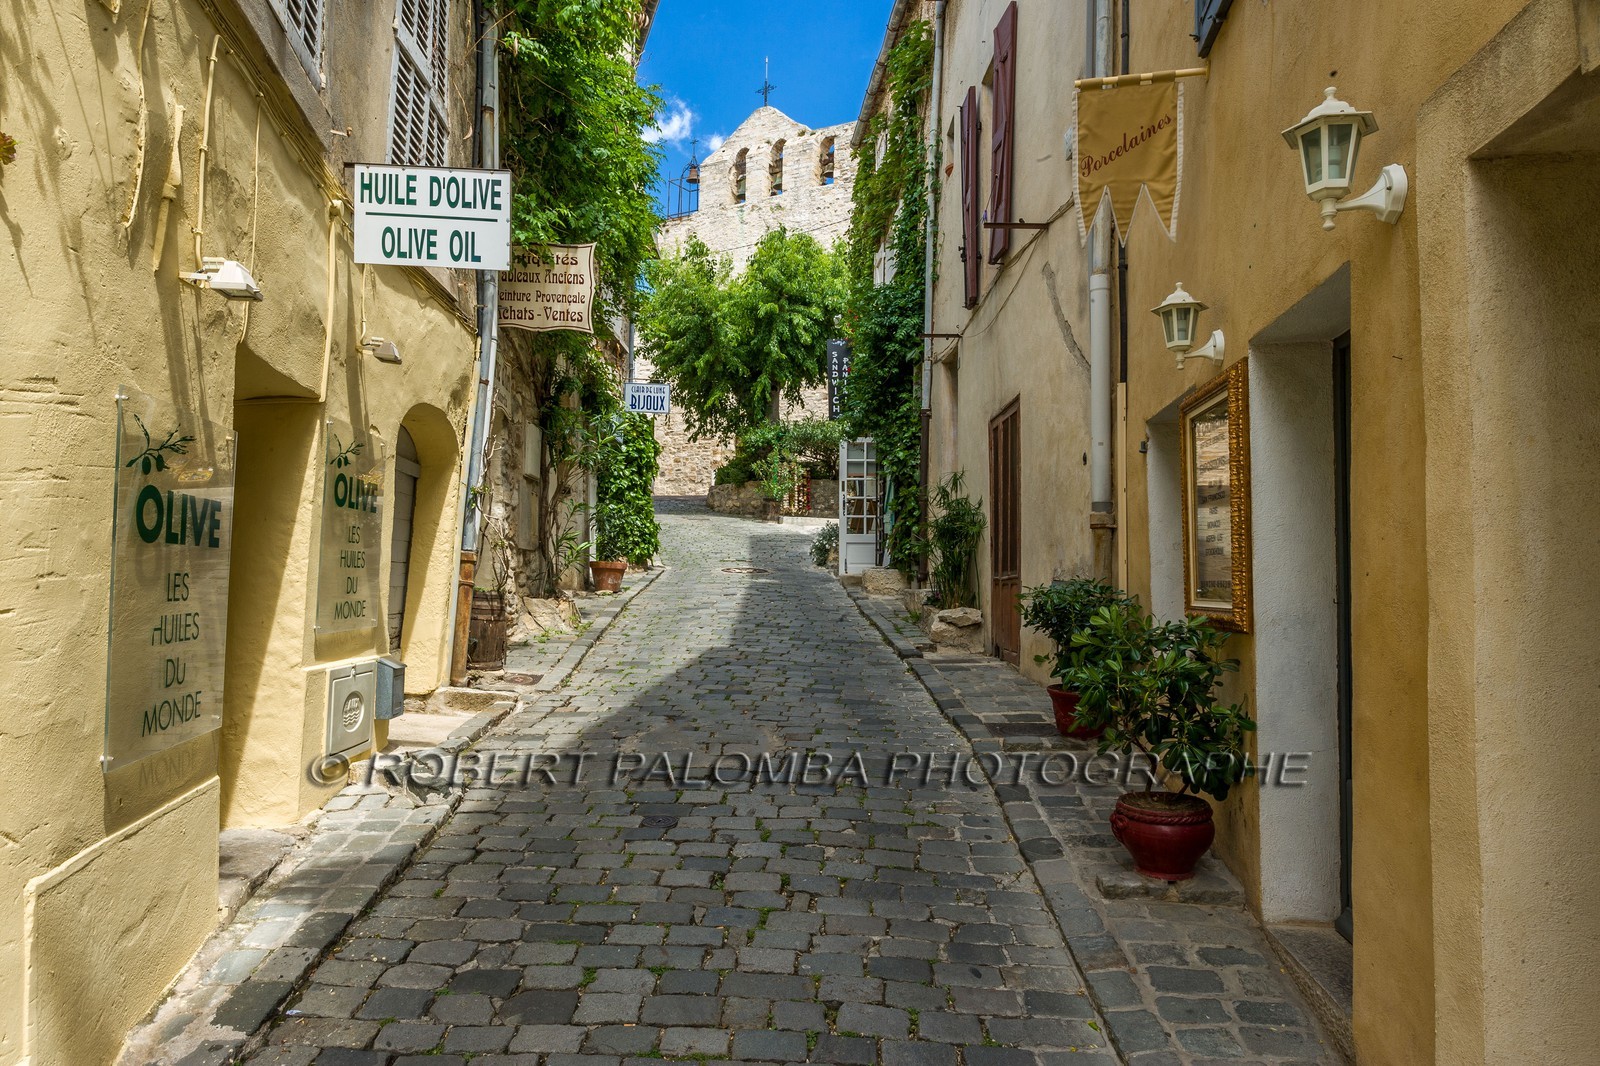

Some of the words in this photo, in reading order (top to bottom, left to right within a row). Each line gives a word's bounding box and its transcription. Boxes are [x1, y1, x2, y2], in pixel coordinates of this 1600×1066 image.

[1080, 113, 1172, 178] Porcelaines
[360, 172, 417, 206] HUILE
[429, 175, 502, 211] D'OLIVE
[381, 226, 438, 261] OLIVE
[449, 229, 482, 263] OIL
[499, 269, 541, 283] ableaux
[544, 269, 585, 285] Anciens
[498, 289, 531, 302] einture
[535, 290, 586, 306] Provençale
[543, 306, 583, 322] Ventes
[831, 351, 840, 413] SANDWICH
[629, 394, 665, 411] BIJOUX
[334, 472, 378, 514] OLIVE
[136, 484, 221, 549] OLIVE
[347, 525, 361, 545] LES
[340, 549, 366, 569] HUILES
[166, 572, 190, 603] LES
[346, 576, 358, 595] DU
[334, 600, 366, 620] MONDE
[151, 612, 200, 646] HUILES
[165, 658, 186, 689] DU
[141, 691, 202, 738] MONDE
